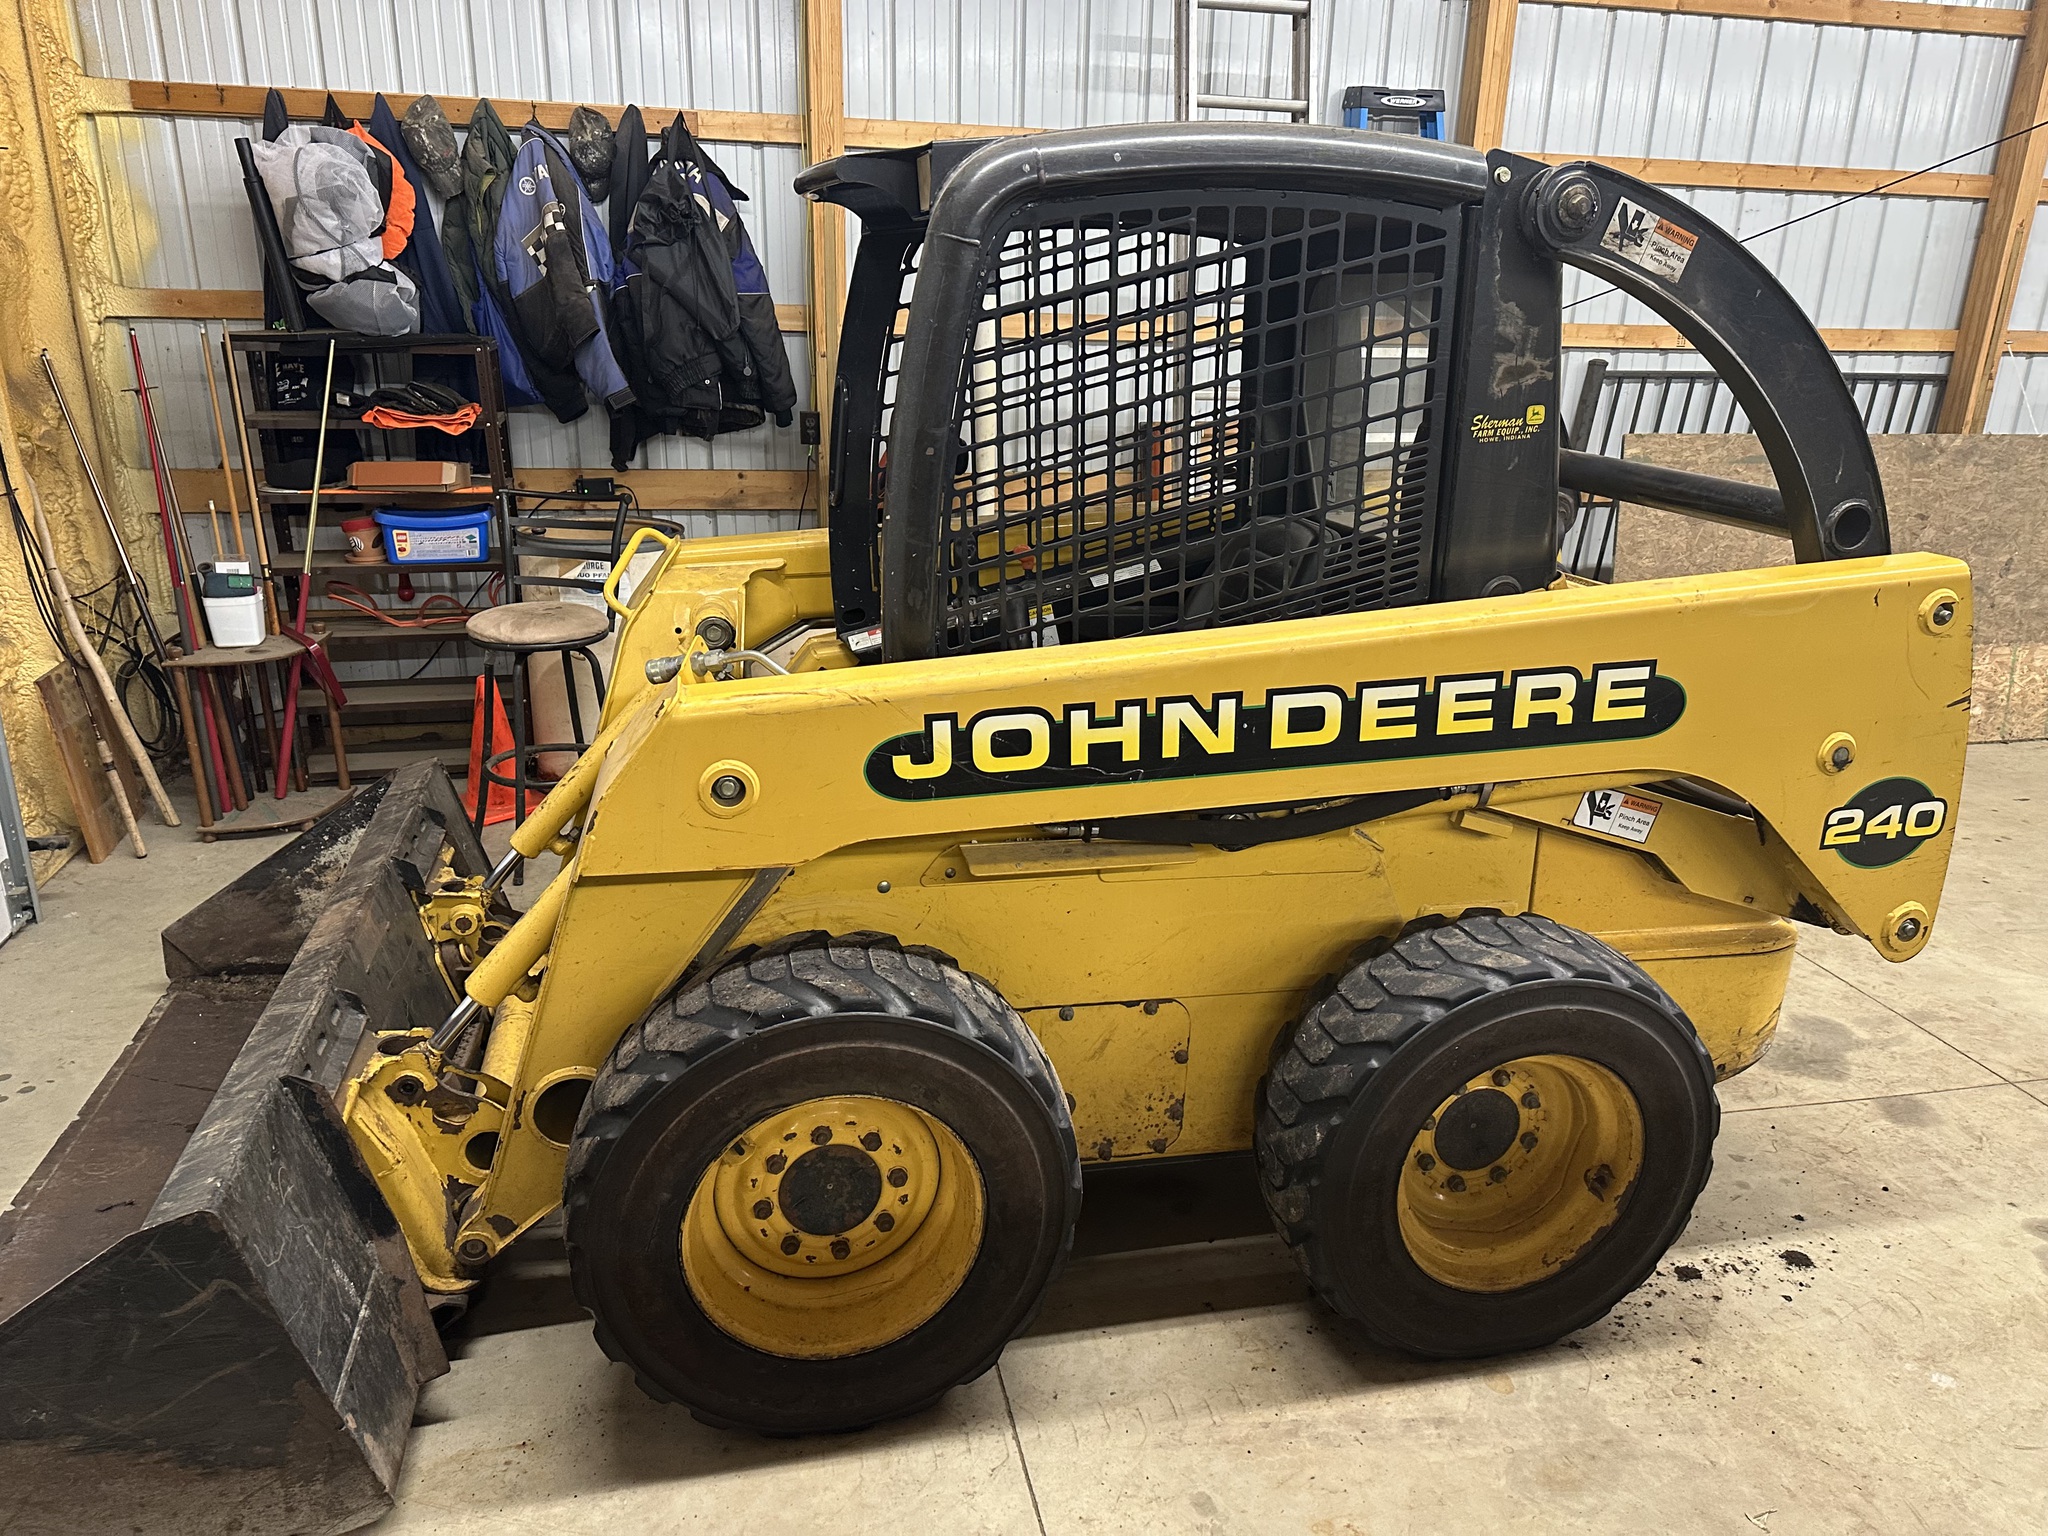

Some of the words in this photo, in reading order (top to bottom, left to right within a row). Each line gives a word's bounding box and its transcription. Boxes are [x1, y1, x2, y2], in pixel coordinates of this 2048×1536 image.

[1664, 226, 1695, 247] WARNING
[1650, 254, 1663, 266] Keep
[1651, 241, 1670, 256] Pinch
[1670, 251, 1685, 264] Area
[1471, 414, 1524, 431] Sherman
[1473, 429, 1494, 438] FARM
[1525, 425, 1540, 433] INC.
[892, 698, 1237, 780] JOHN
[1270, 666, 1651, 749] DEERE
[1631, 800, 1658, 813] WARNING
[1619, 812, 1635, 823] Pinch
[1636, 817, 1650, 827] Area
[1823, 801, 1945, 846] 240
[1618, 823, 1630, 831] Keep
[1631, 826, 1643, 835] Away
